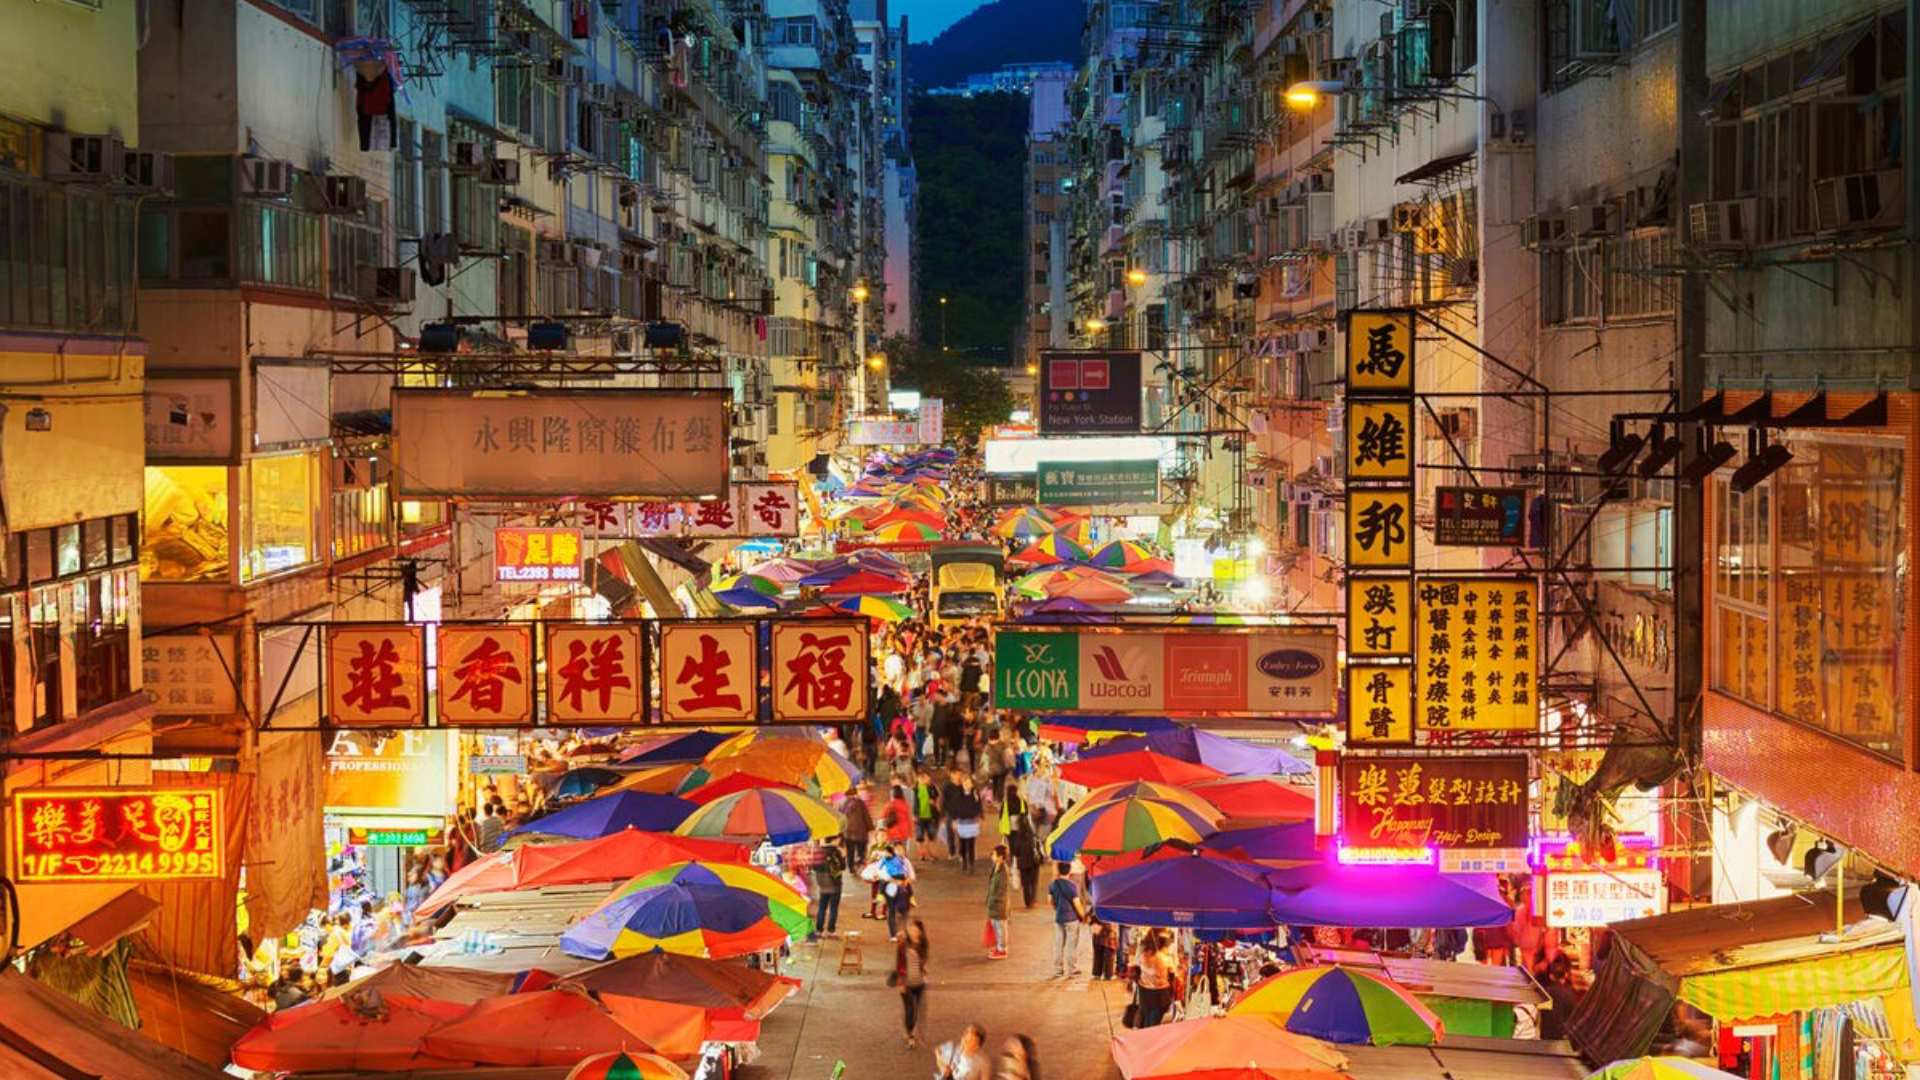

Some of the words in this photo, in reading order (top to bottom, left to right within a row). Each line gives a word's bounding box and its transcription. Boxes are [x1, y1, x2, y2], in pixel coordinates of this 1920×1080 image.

[1048, 415, 1071, 425] New
[1073, 415, 1095, 425] York
[1098, 415, 1134, 425] Station
[1355, 323, 1406, 557] 馬維邦
[1363, 583, 1397, 651] 跌打
[1006, 668, 1069, 699] LEONA
[1180, 667, 1233, 685] Triumph
[1090, 683, 1151, 698] Wacoal
[1268, 685, 1312, 698] 安莉芳
[1365, 671, 1397, 738] 骨醫
[1465, 828, 1502, 846] Design
[24, 854, 62, 876] 1/F
[98, 853, 152, 873] 2214
[159, 852, 213, 873] 9995
